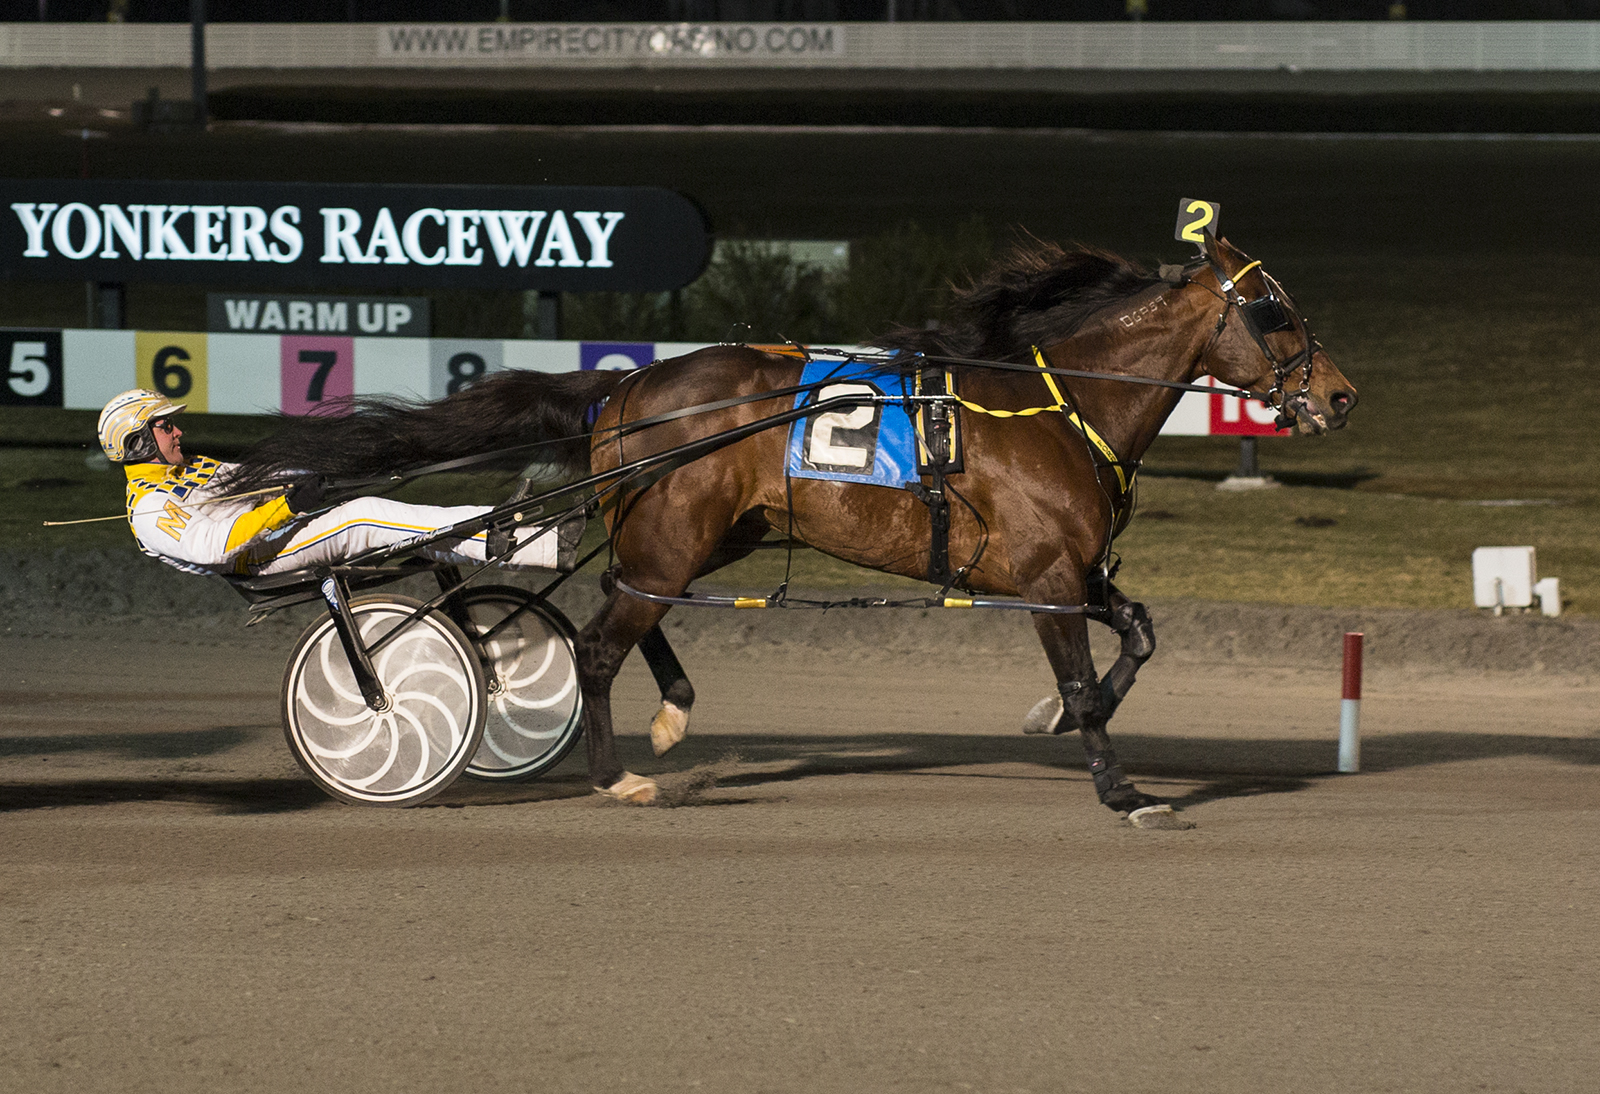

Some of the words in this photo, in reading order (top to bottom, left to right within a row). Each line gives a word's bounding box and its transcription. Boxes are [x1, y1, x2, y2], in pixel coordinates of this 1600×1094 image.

[10, 202, 304, 264] YONKERS
[319, 206, 625, 268] RACEWAY
[1181, 200, 1214, 243] 2
[224, 299, 348, 332] WARM
[357, 302, 413, 333] UP
[8, 340, 51, 397] 5
[151, 345, 193, 399] 6
[297, 350, 338, 401] 7
[809, 383, 877, 468] 2
[156, 499, 193, 543] M
